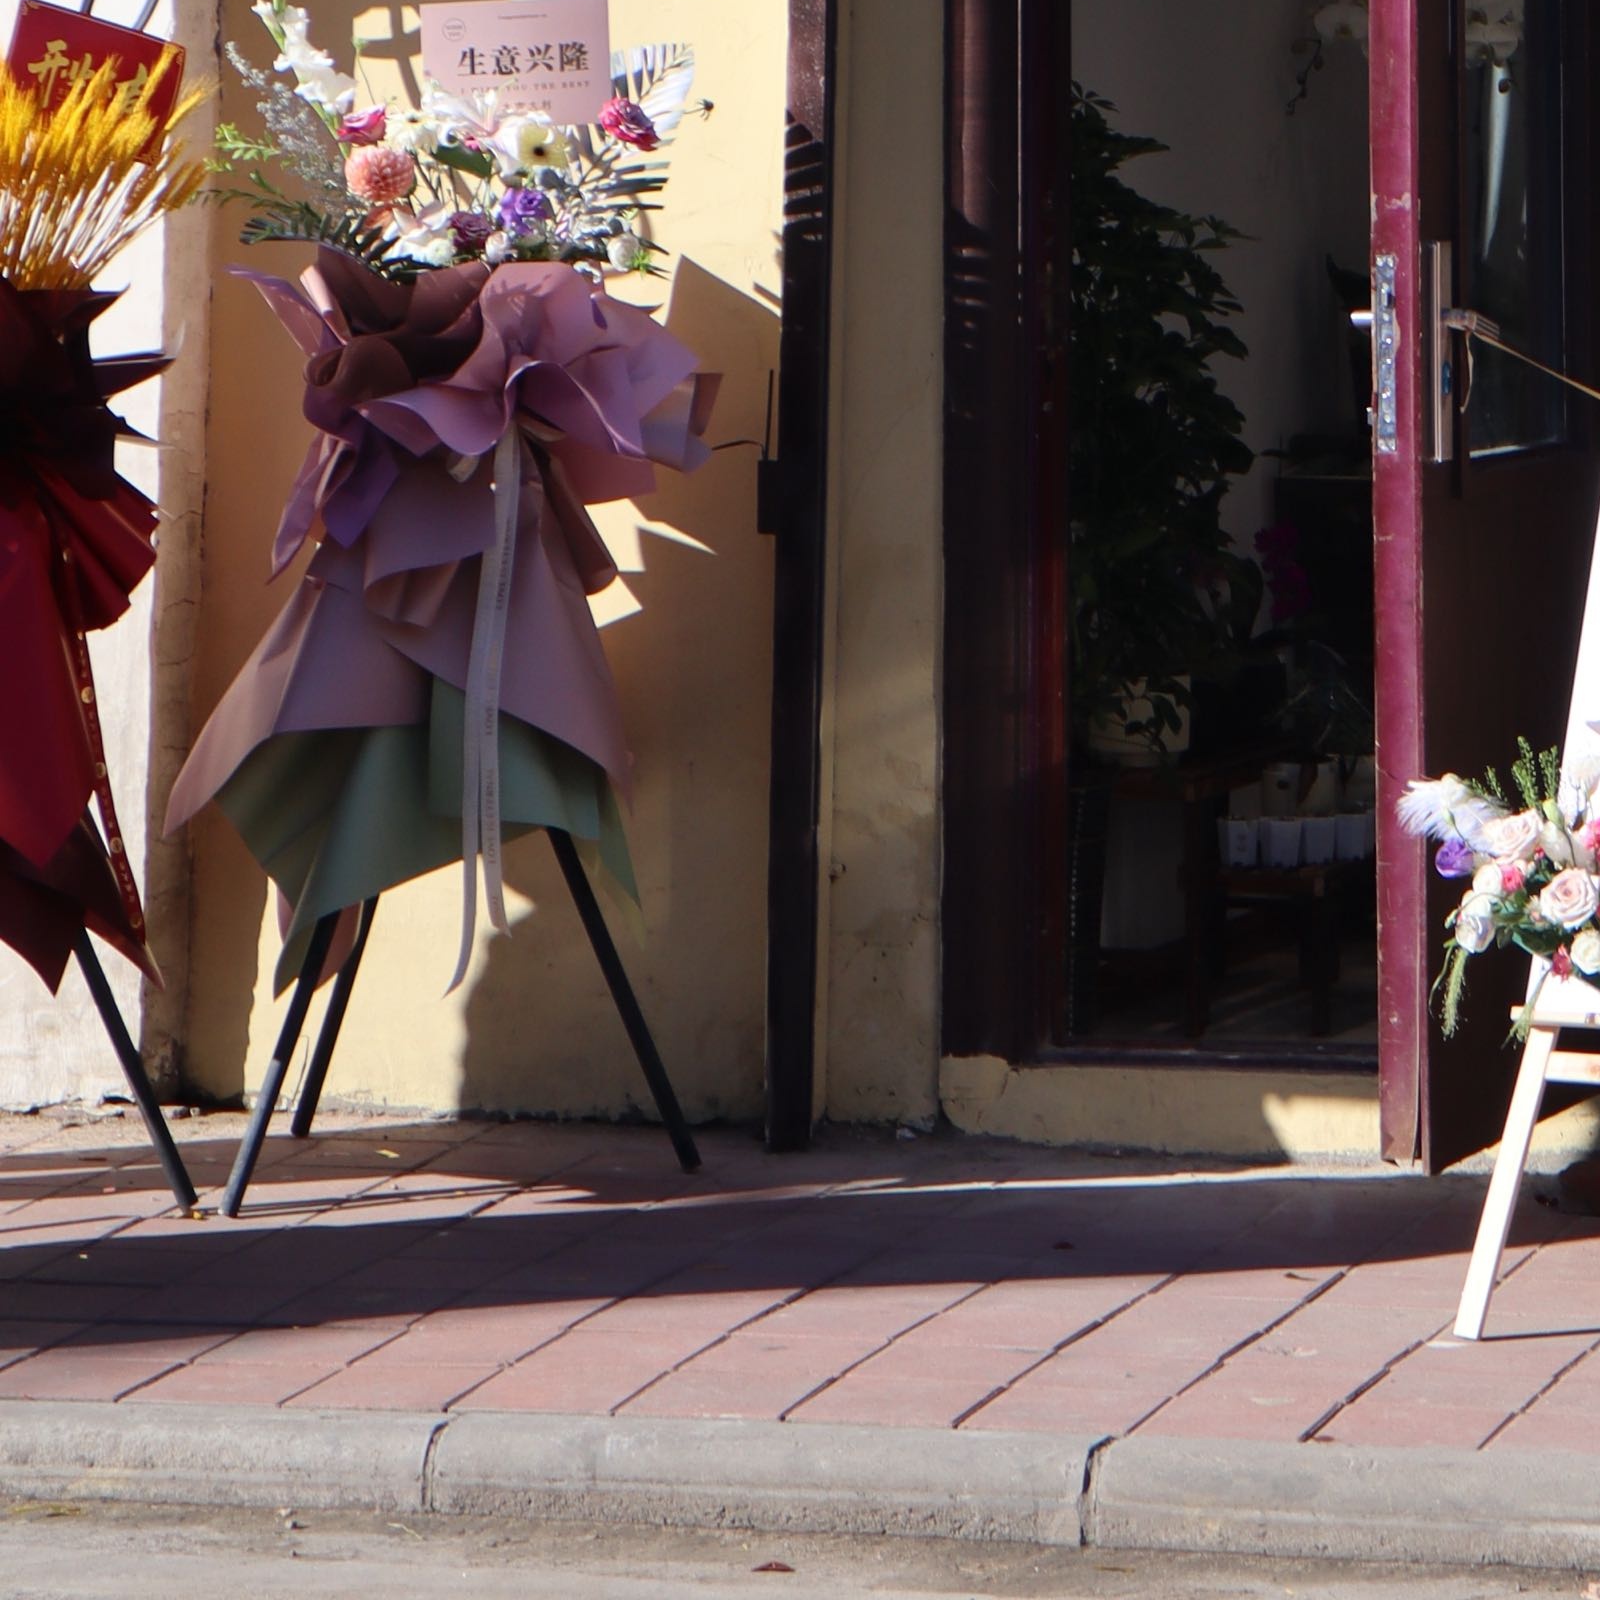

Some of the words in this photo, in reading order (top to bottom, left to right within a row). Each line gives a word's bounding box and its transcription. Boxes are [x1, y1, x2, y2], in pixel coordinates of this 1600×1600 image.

[27, 39, 149, 115] 开业吉
[457, 41, 590, 77] 生意兴隆
